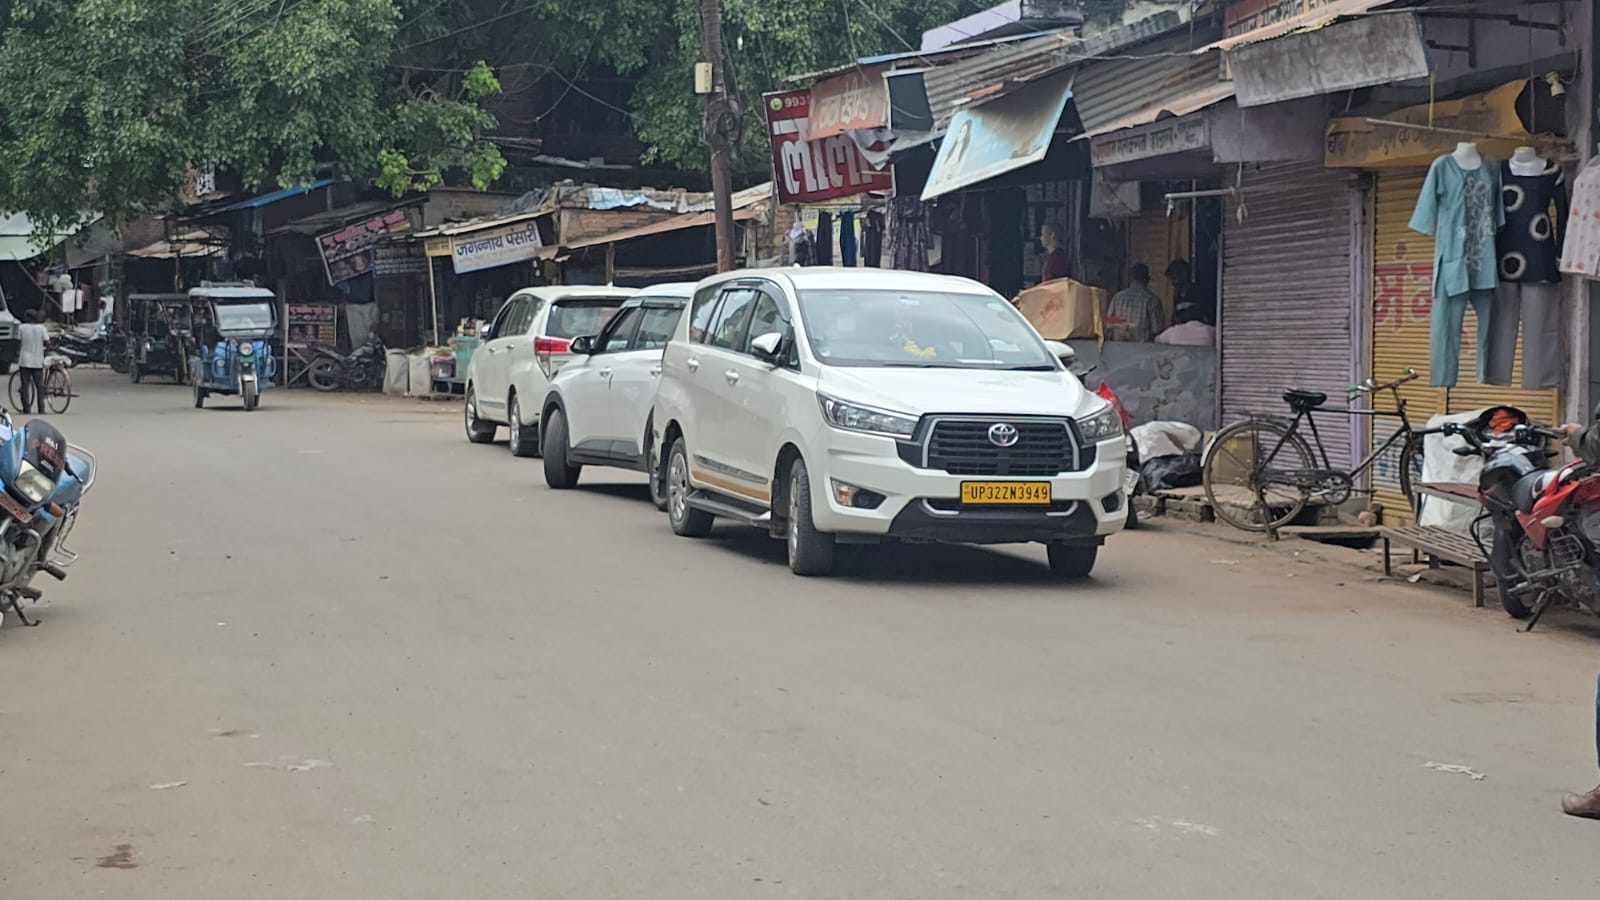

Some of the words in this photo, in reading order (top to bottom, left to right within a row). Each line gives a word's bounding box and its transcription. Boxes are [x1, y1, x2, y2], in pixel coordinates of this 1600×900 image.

[785, 95, 809, 108] 993
[456, 236, 503, 256] जगन्नाथ
[505, 223, 537, 245] पंसारी
[970, 486, 1048, 500] UP32ZN3949
